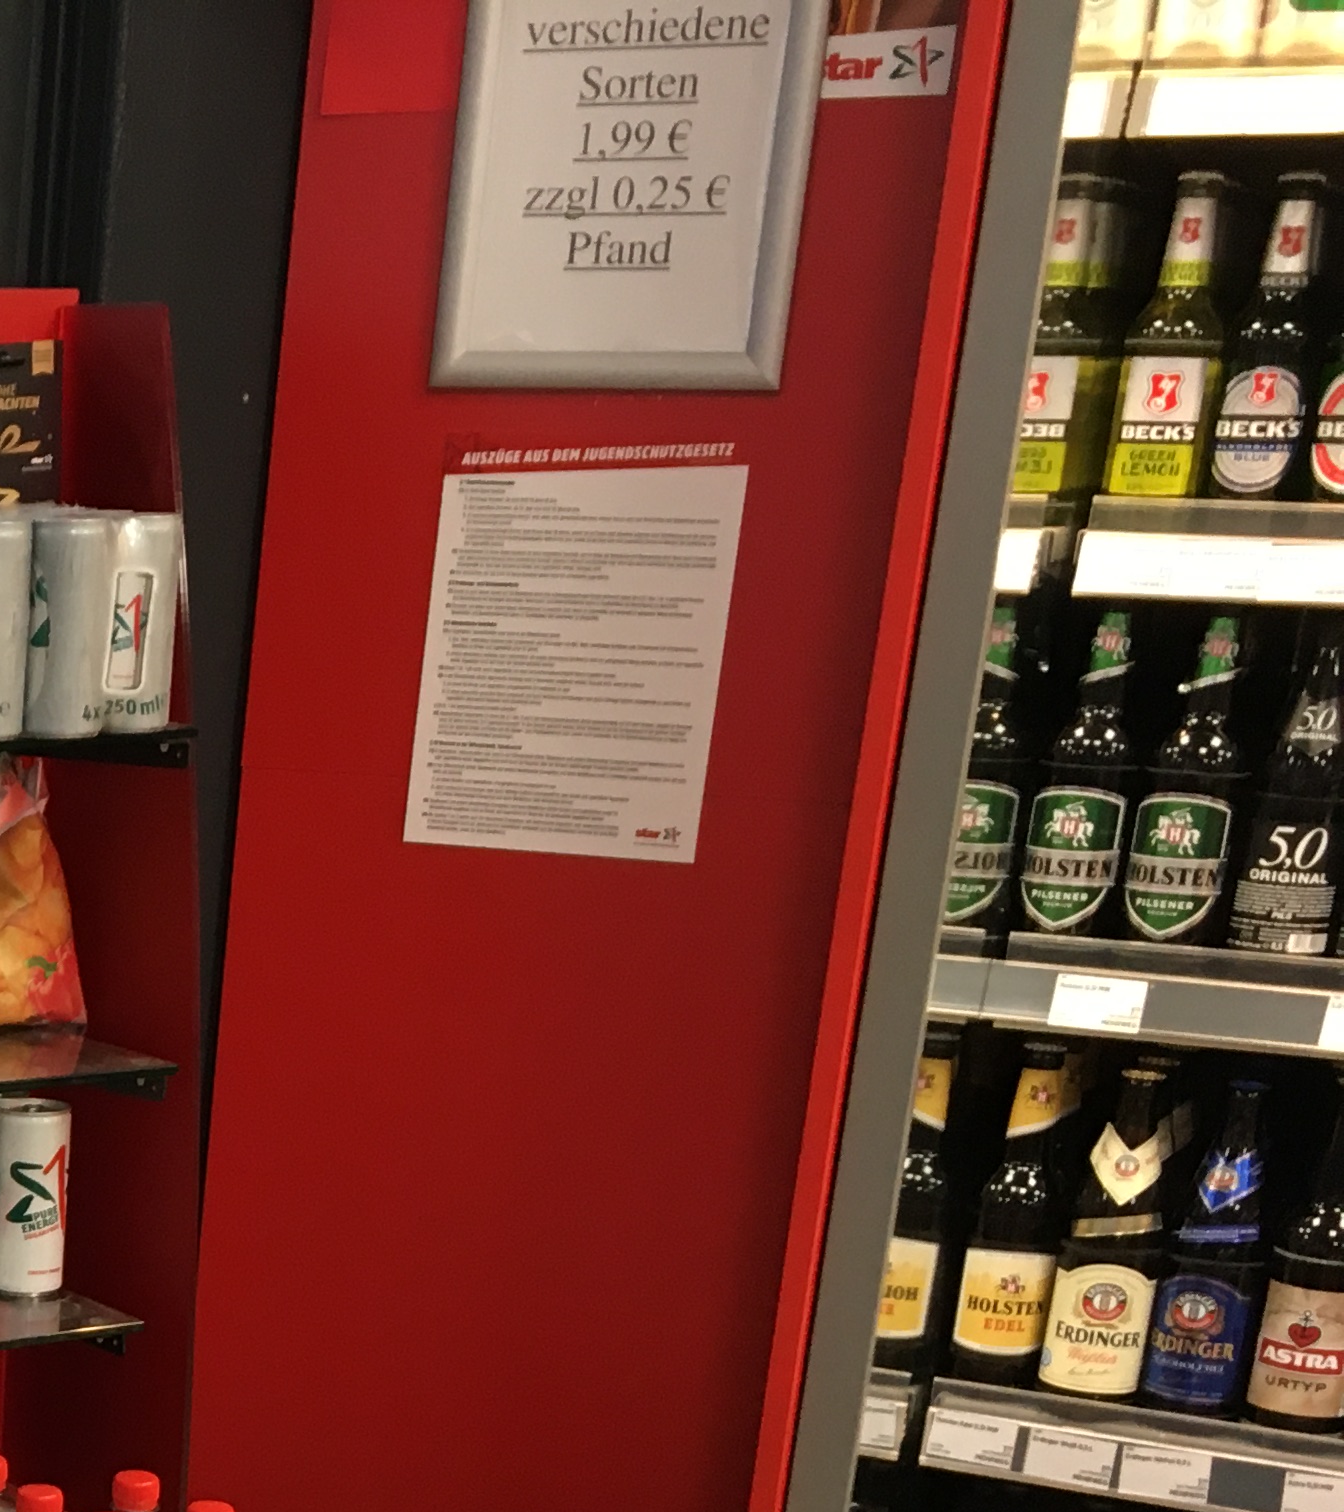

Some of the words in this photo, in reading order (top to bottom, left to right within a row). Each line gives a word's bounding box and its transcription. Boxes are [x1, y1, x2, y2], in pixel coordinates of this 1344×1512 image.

[526, 5, 770, 48] verschiedene
[823, 52, 884, 82] tar
[578, 65, 700, 101] Sorten
[578, 119, 657, 159] 1,99
[667, 118, 693, 155] €
[523, 175, 600, 219] zzgl
[612, 176, 693, 215] 0,25
[705, 174, 731, 210] €
[566, 229, 673, 265] Pfand
[1120, 424, 1196, 441] BECK'S
[1215, 418, 1301, 438] BECK'S
[462, 448, 521, 466] AUSZÜGE
[523, 449, 549, 463] AUS
[552, 448, 582, 462] DEM
[583, 442, 735, 461] JUGENDSCHUTZGESETZ
[1258, 825, 1329, 869] 5,0
[1249, 868, 1329, 885] ORIGINAL
[1031, 888, 1088, 901] PILSENER
[1135, 896, 1195, 910] PILSENER
[983, 1317, 1025, 1332] EDEL
[1055, 1320, 1141, 1348] ERDINGER
[1263, 1344, 1339, 1370] ASTRA
[1265, 1374, 1327, 1393] URTYP
